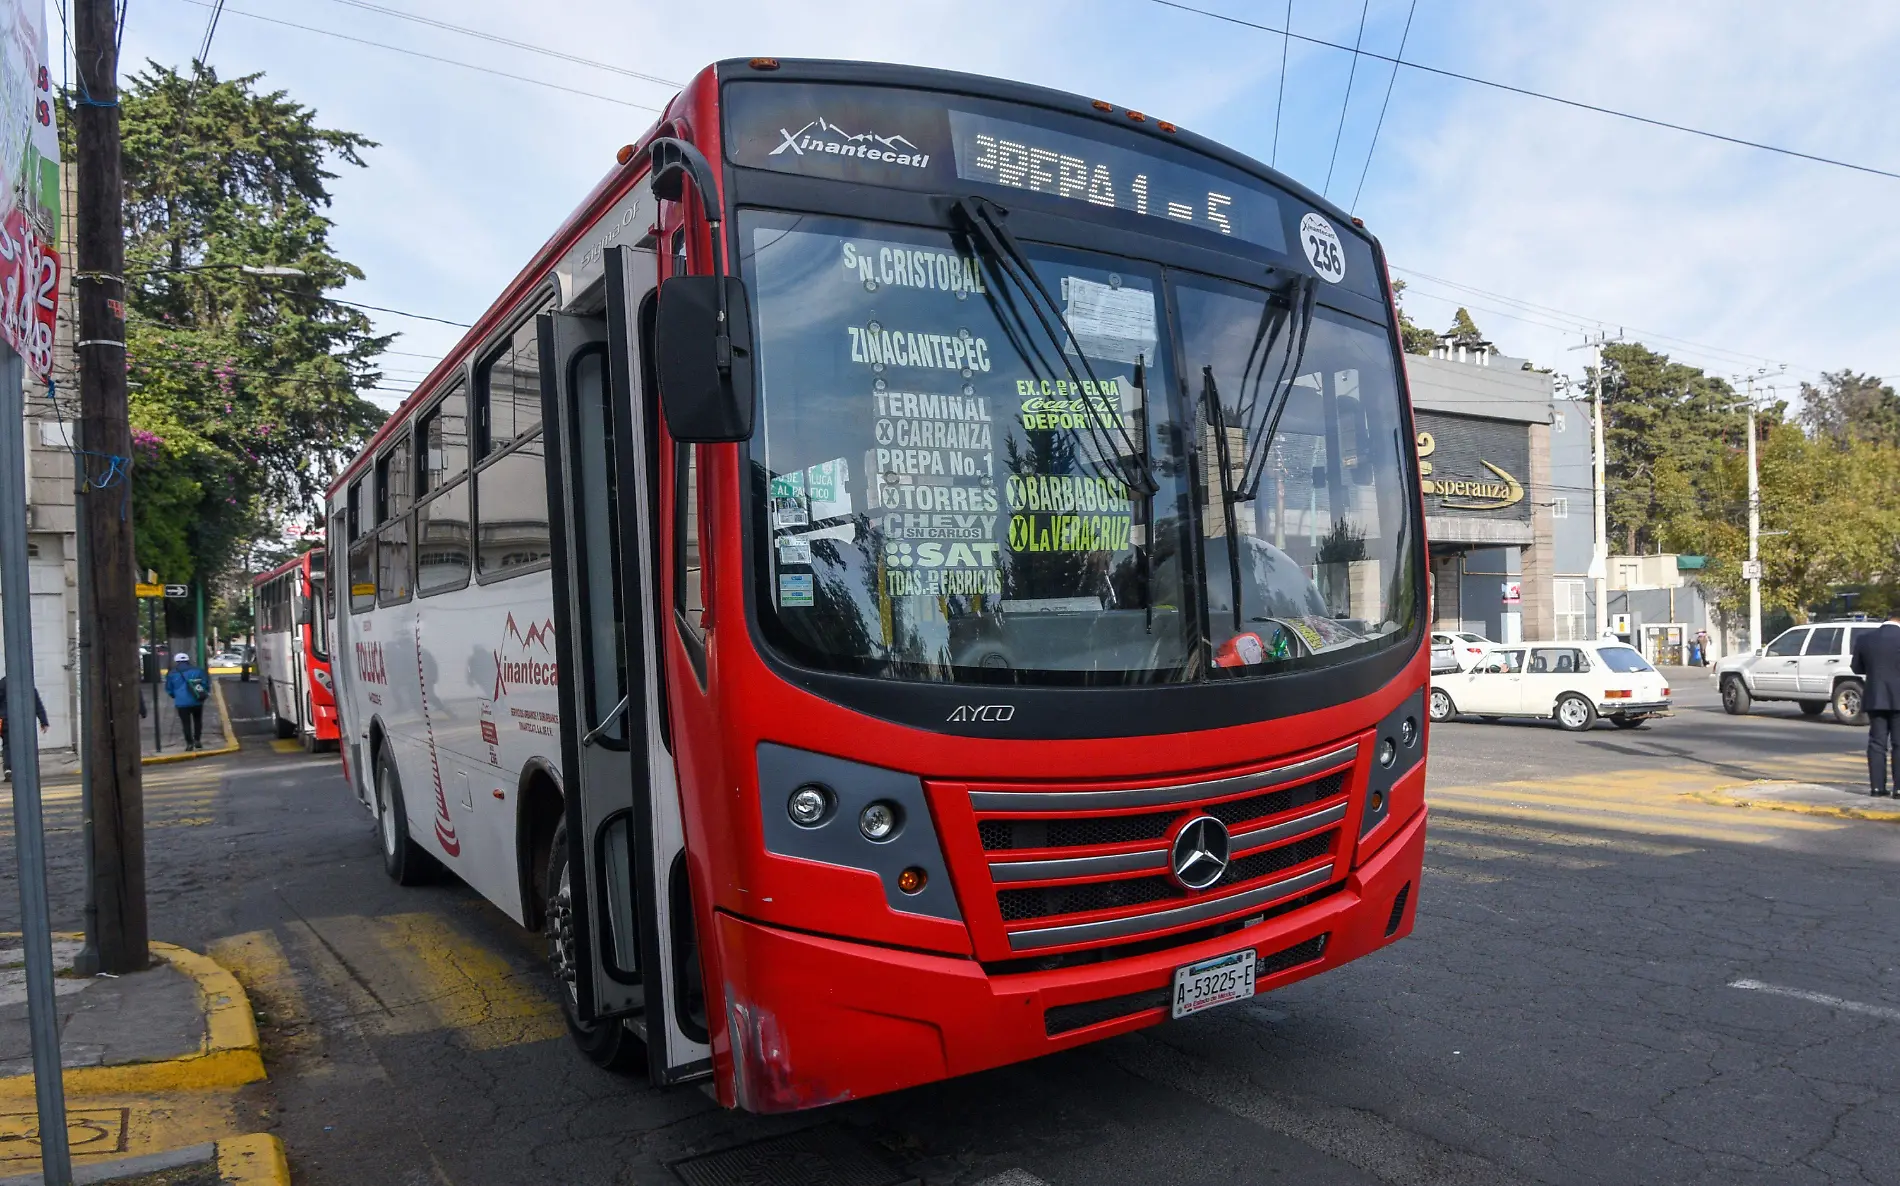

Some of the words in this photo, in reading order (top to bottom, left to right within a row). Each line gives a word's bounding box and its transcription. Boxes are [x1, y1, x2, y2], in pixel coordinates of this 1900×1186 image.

[768, 126, 930, 168] Xinantecatl
[1132, 174, 1147, 214] 1
[1309, 234, 1342, 276] 236
[848, 326, 991, 372] ZINACANTEPEC
[1016, 380, 1039, 396] EX.
[1040, 380, 1056, 396] C.
[1069, 380, 1119, 396] PEDRA
[873, 391, 991, 421] TERMINAL
[897, 419, 992, 450] CARRANZA
[876, 449, 944, 475] PREPA
[949, 451, 980, 476] No.
[983, 452, 993, 477] 1
[901, 485, 998, 512] TORRES
[1026, 475, 1130, 512] BARBABOSA
[1422, 478, 1512, 502] speranza
[883, 512, 997, 539] CHEVY
[906, 528, 925, 538] SN
[928, 528, 980, 538] CARLOS
[916, 542, 999, 567] SAT
[940, 569, 1002, 596] FABRICAS
[1177, 964, 1253, 1004] A-53225-E
